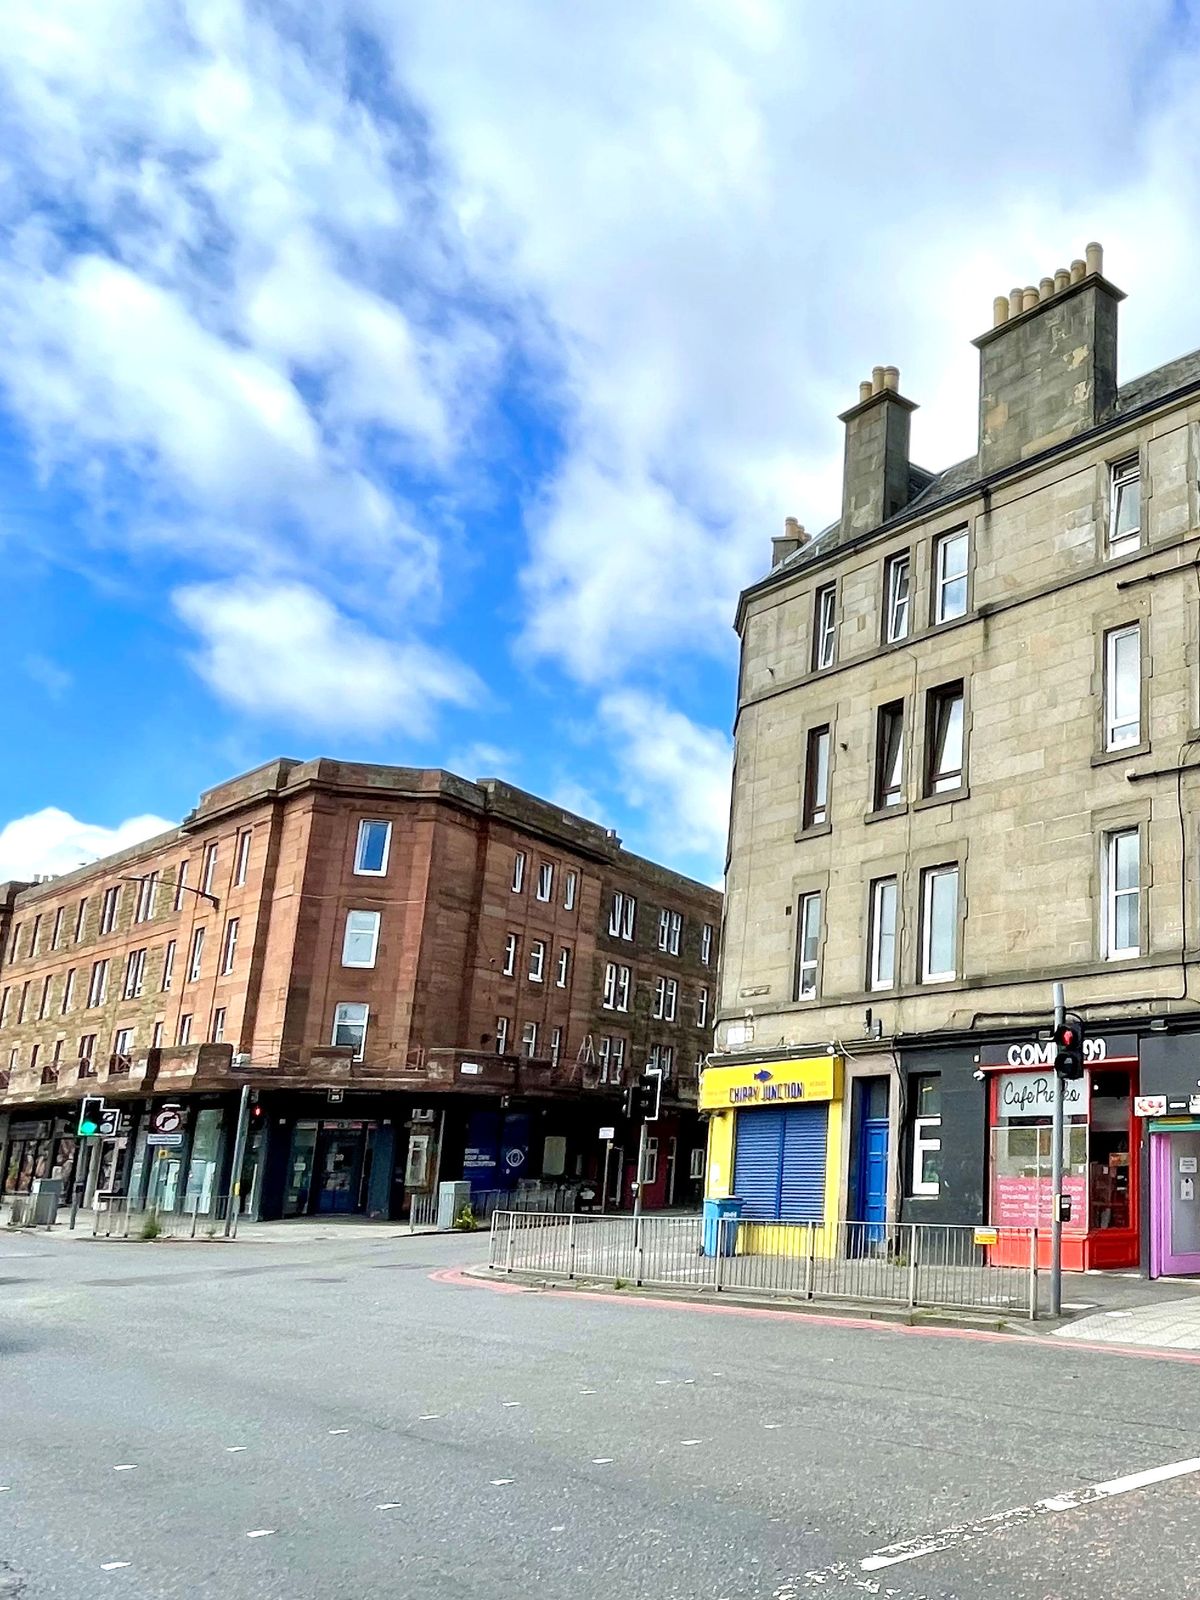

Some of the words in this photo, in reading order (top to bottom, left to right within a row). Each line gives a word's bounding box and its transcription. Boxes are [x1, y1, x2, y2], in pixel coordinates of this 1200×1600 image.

[729, 1086, 759, 1104] CHIPPY
[762, 1082, 805, 1101] JUNCTION
[1003, 1081, 1035, 1111] Cafe
[1033, 1078, 1081, 1104] Preko
